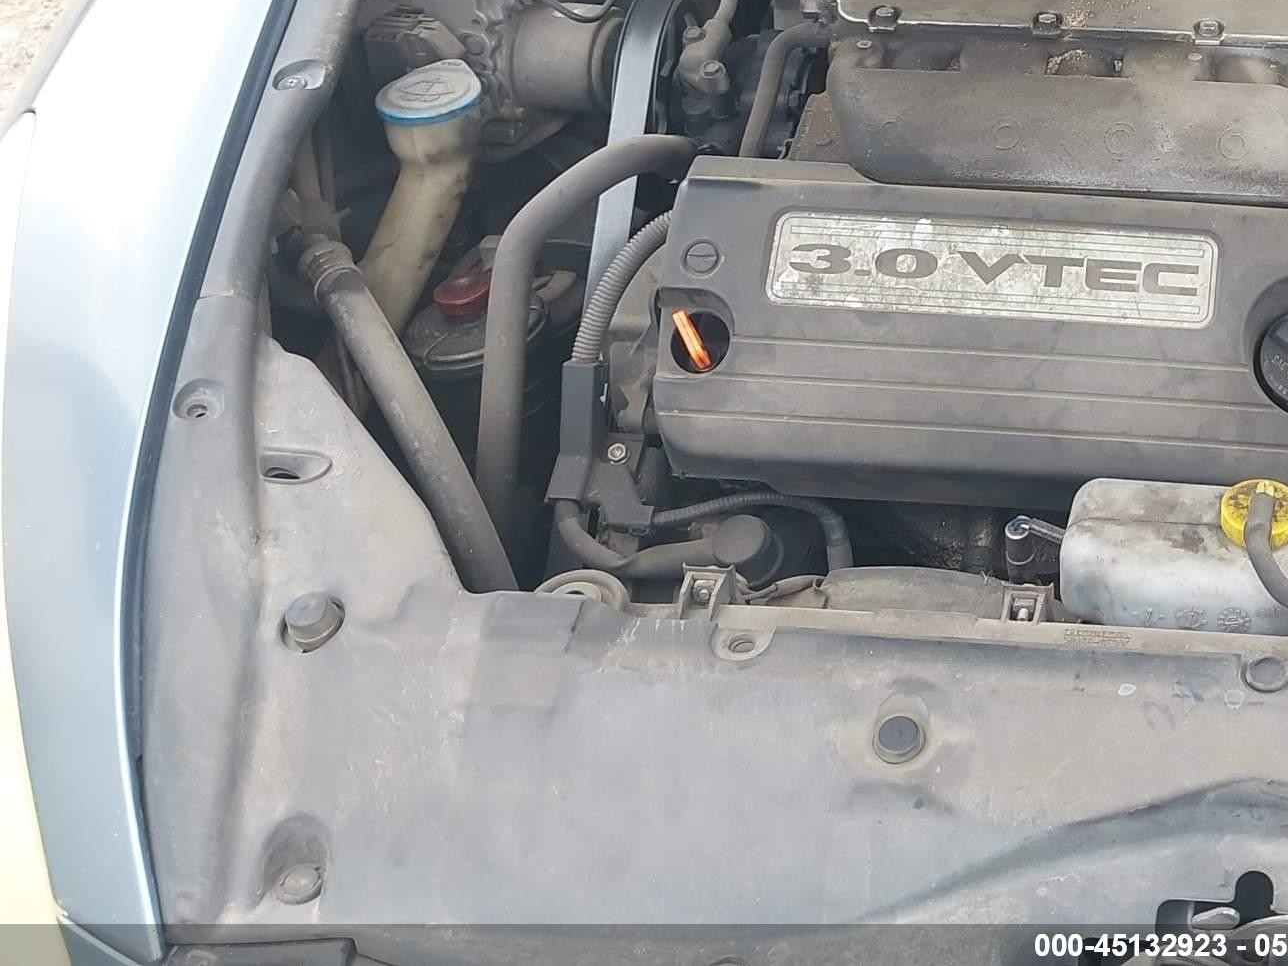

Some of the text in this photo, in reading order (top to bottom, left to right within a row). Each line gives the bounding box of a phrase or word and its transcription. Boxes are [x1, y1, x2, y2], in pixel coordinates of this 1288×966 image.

[788, 243, 1199, 297] 3.0 VTEC
[1271, 354, 1288, 371] SAE
